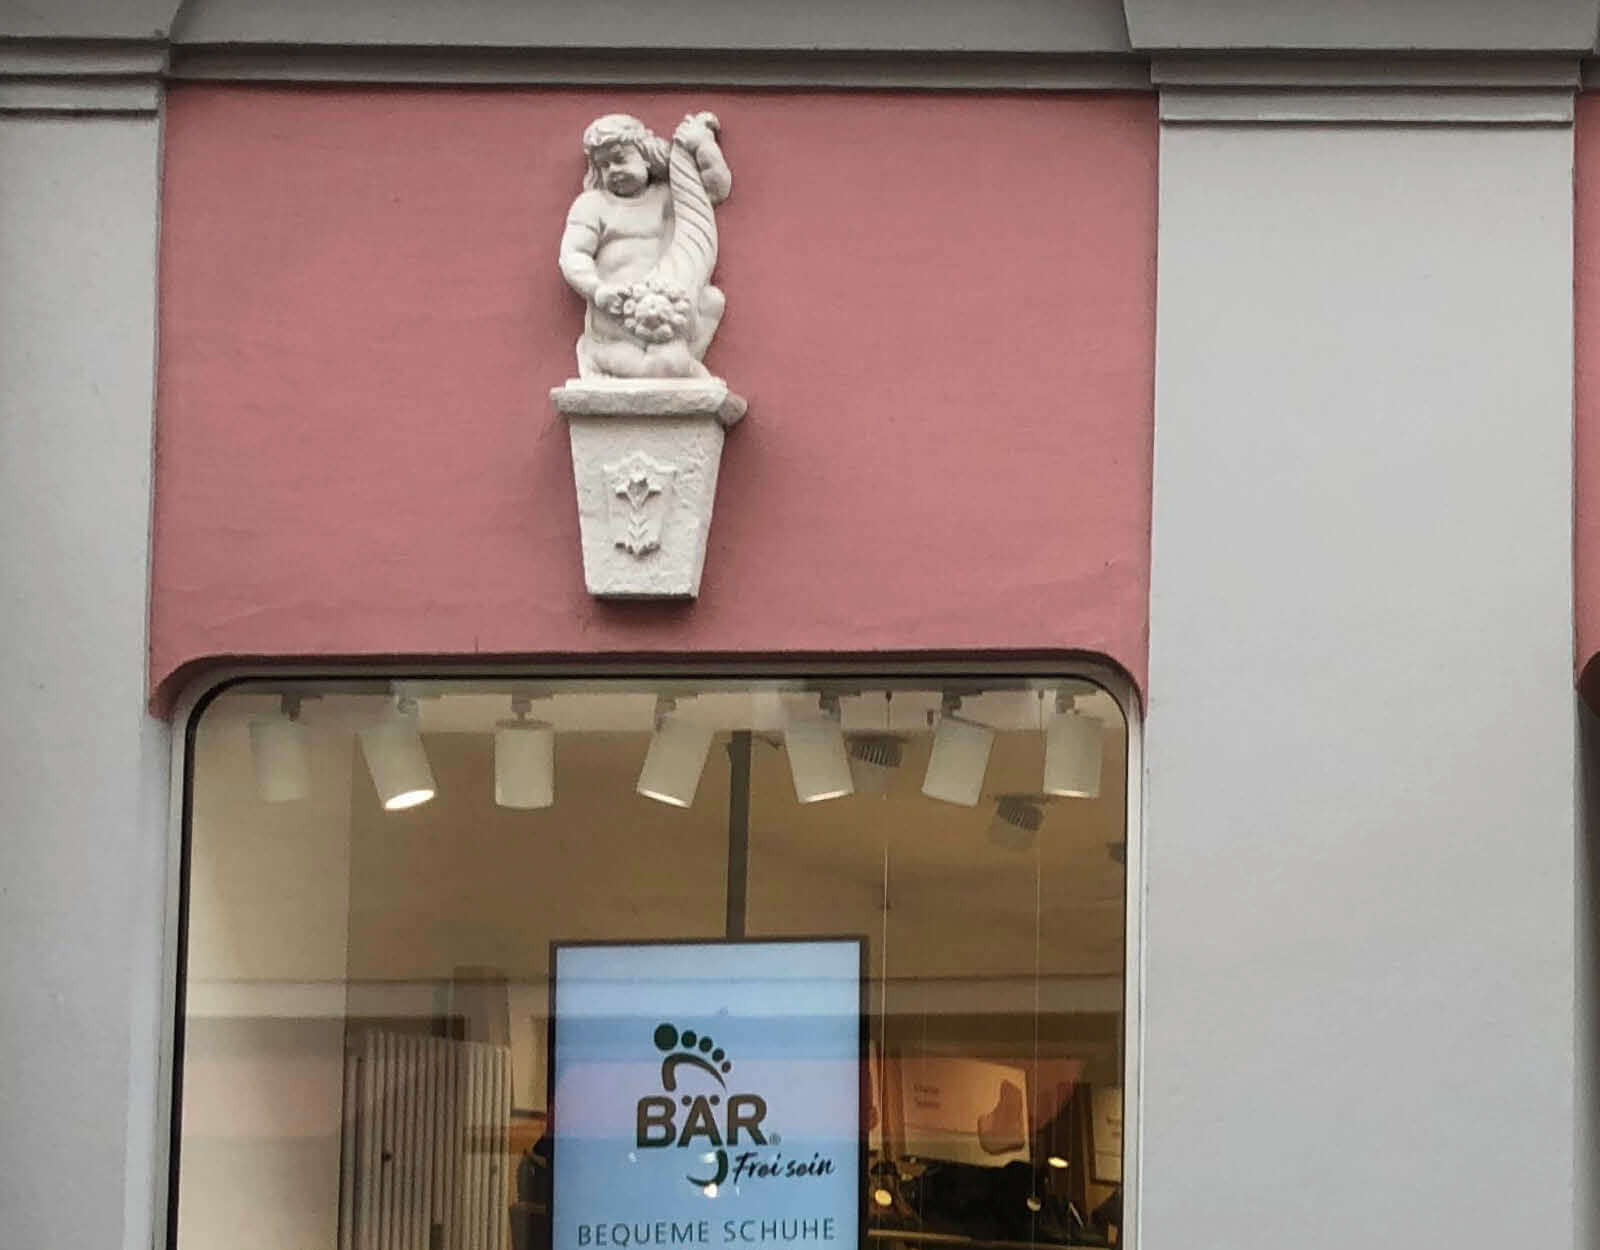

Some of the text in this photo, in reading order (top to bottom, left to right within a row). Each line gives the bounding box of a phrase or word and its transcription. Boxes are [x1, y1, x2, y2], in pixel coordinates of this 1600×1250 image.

[732, 1152, 836, 1184] Frei sein
[578, 1217, 835, 1247] BEQUEME SCHUHE
